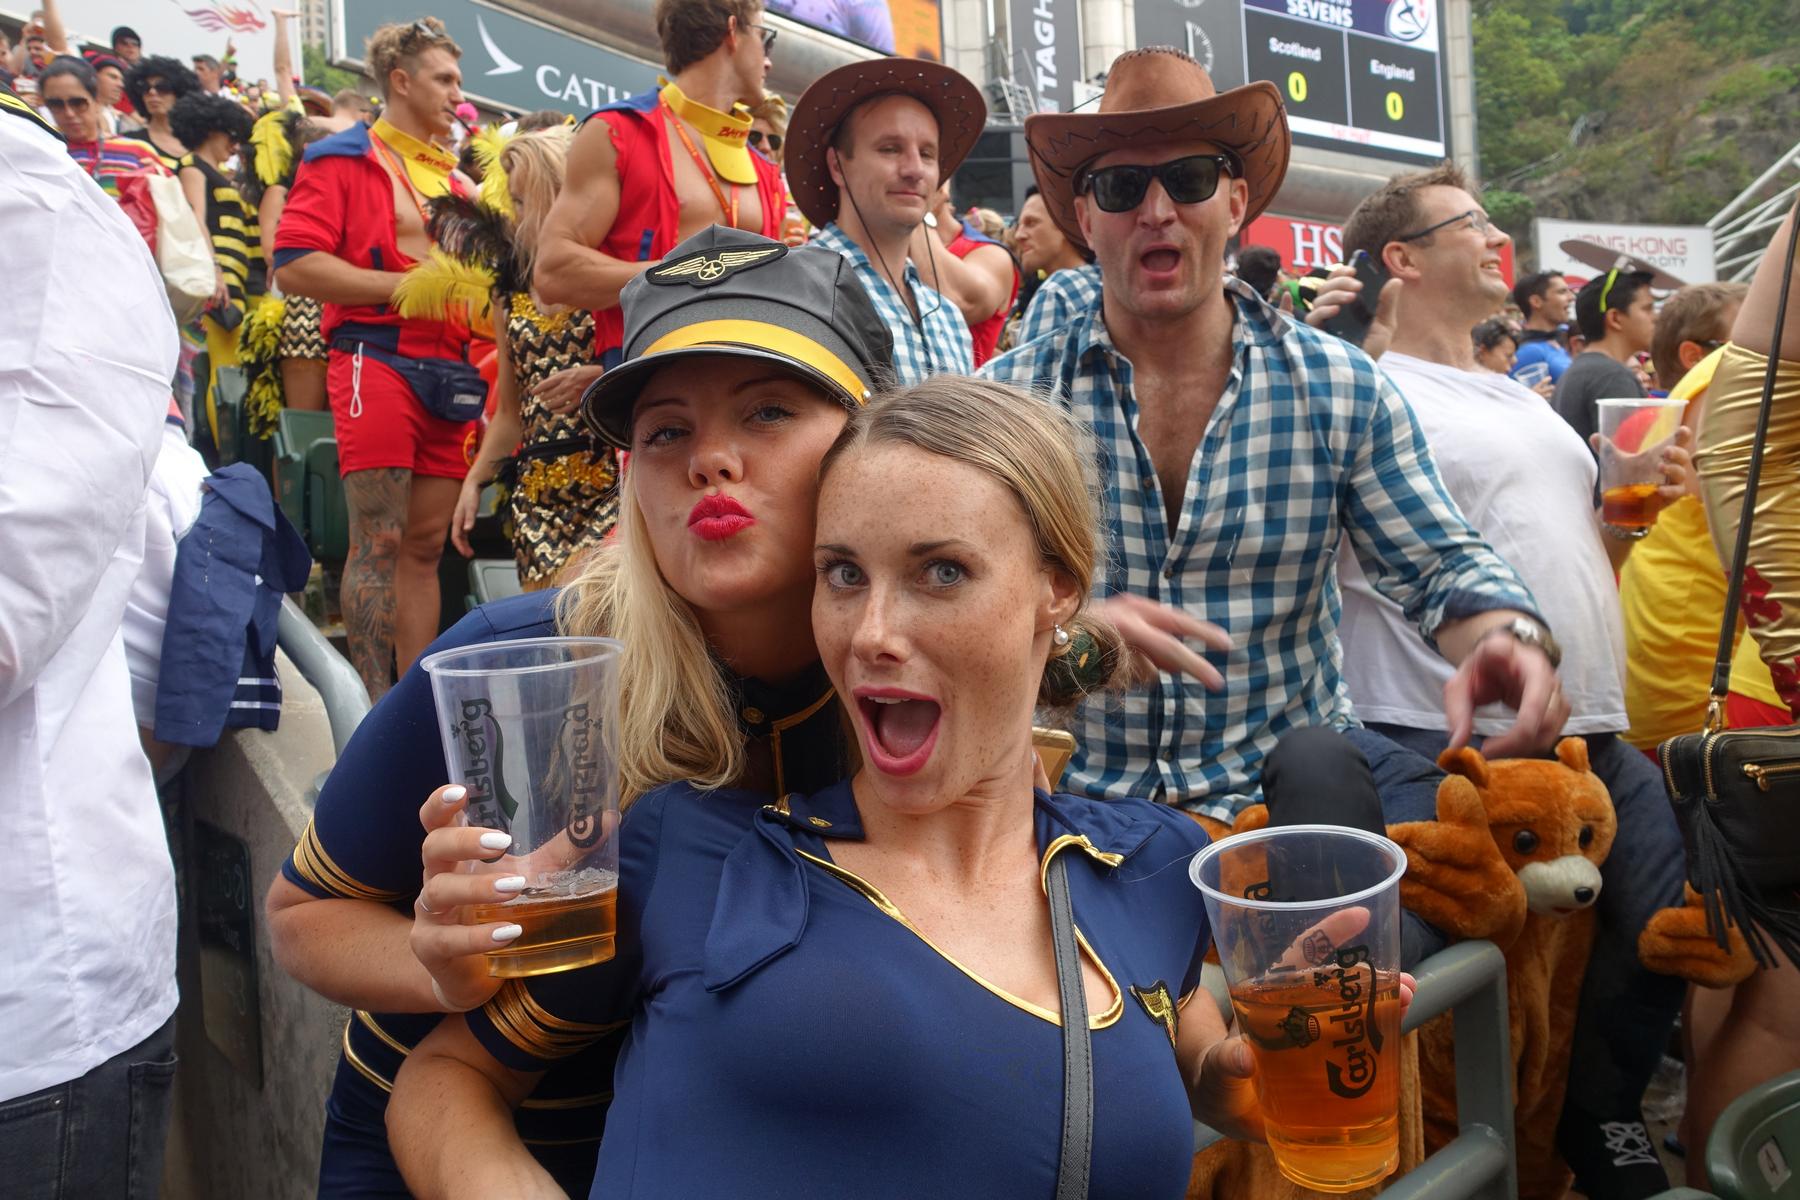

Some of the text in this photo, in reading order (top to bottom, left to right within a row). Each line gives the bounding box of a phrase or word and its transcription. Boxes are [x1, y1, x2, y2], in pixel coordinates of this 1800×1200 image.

[1287, 0, 1354, 28] SEVENS
[1268, 37, 1322, 62] Scotland
[1370, 59, 1416, 82] England
[1288, 71, 1308, 102] 0
[1385, 91, 1405, 121] 0
[1565, 234, 1688, 256] NG KONG
[460, 698, 511, 863] rlsberg
[1326, 944, 1378, 1099] Carlsberg
